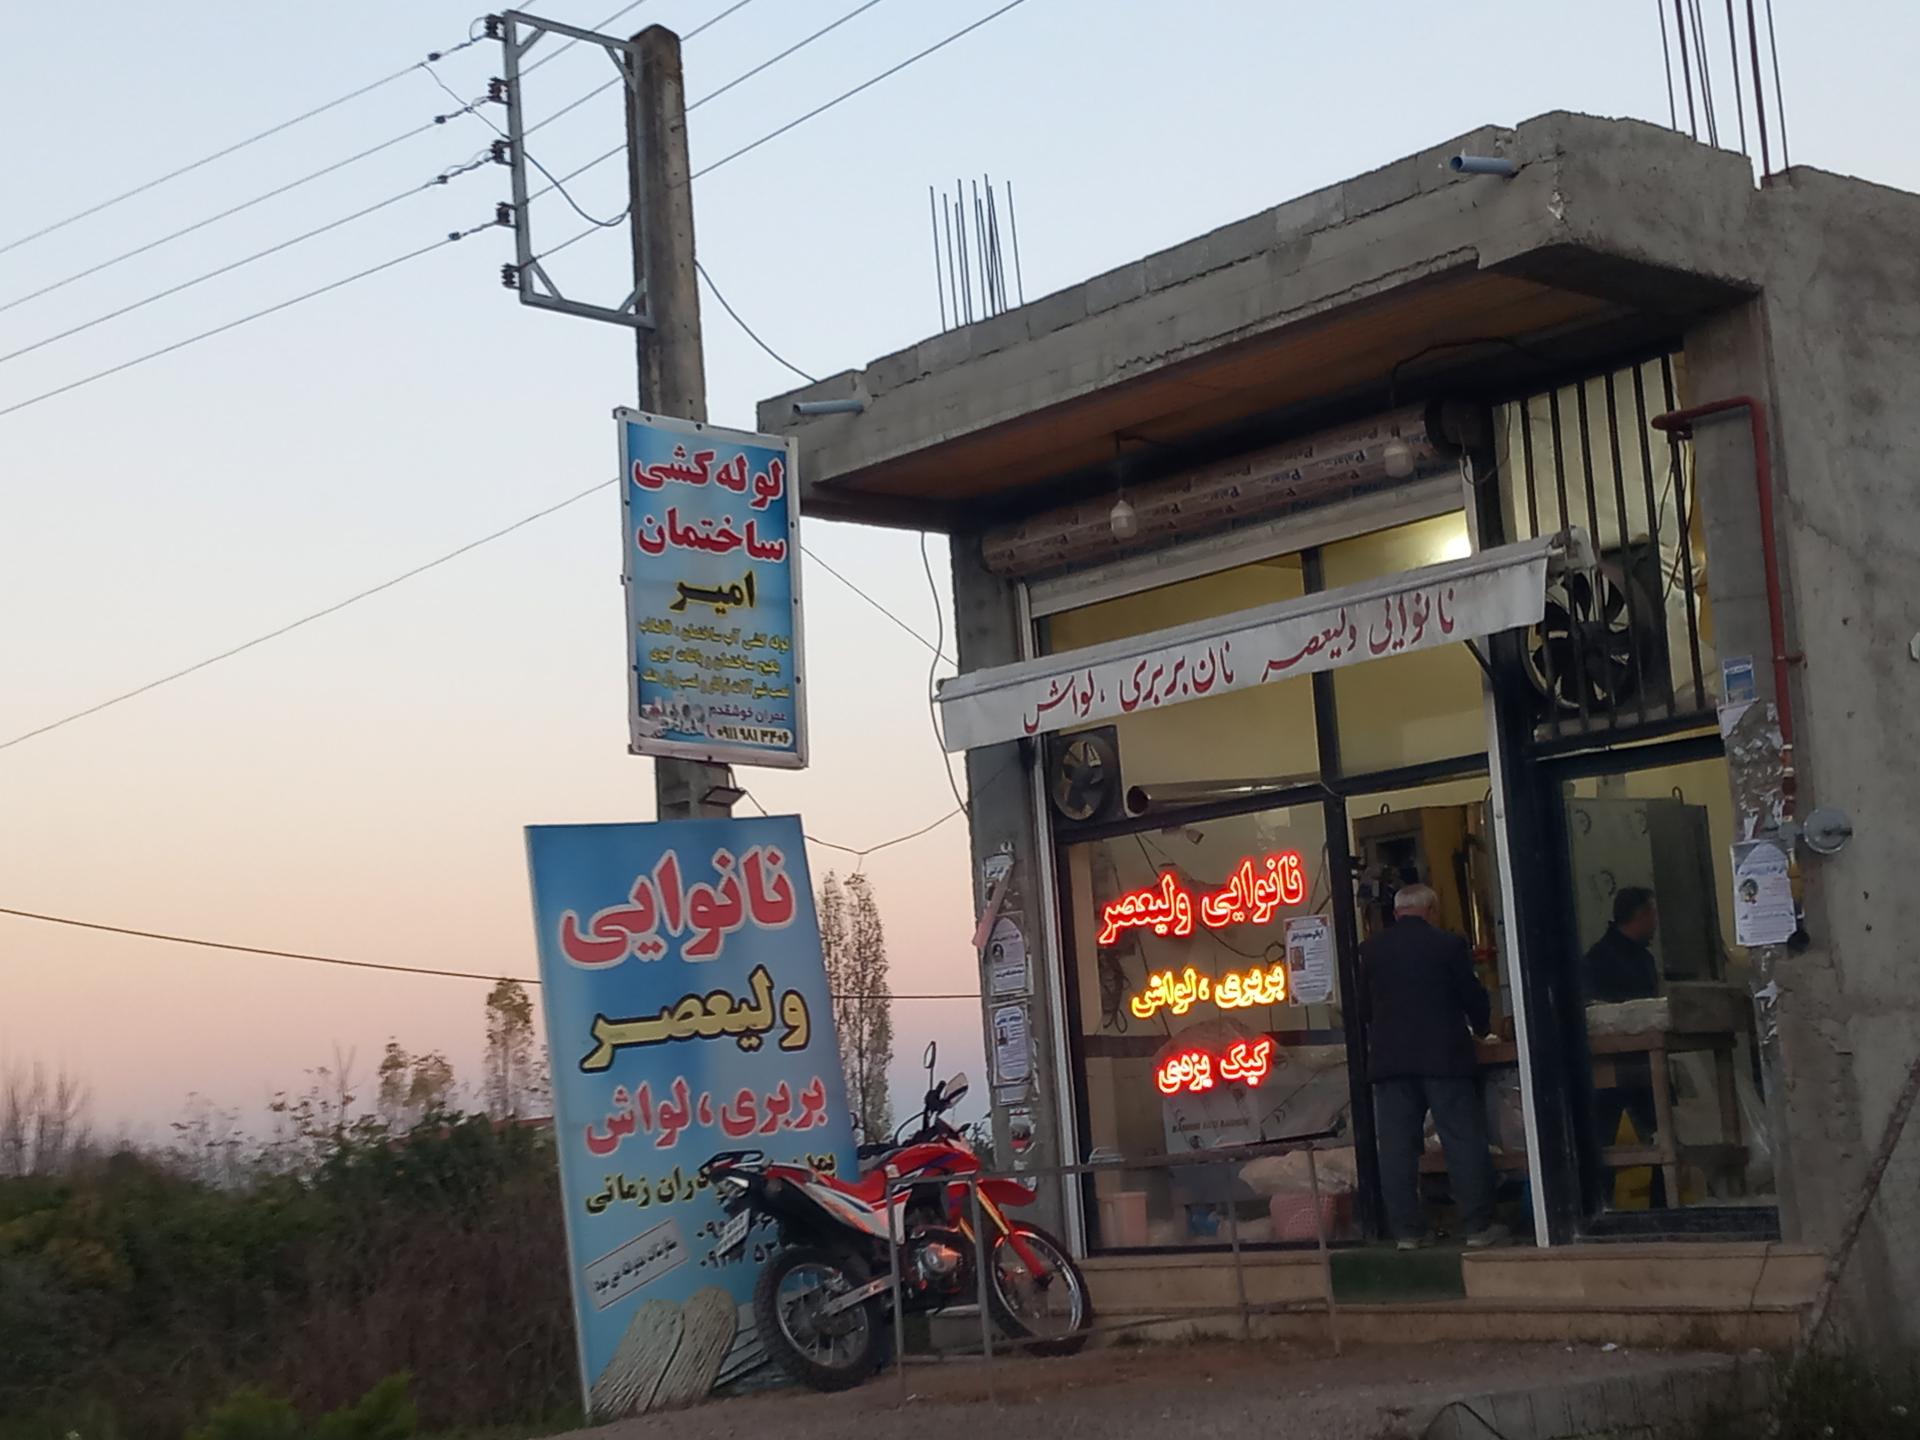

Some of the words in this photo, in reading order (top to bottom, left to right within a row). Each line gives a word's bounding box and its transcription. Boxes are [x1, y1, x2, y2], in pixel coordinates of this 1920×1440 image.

[633, 444, 715, 490] کشی
[716, 453, 784, 509] لوله
[637, 507, 787, 562] ساختمان
[669, 570, 757, 616] امیر
[1261, 606, 1358, 683] ولیعصر
[1369, 588, 1455, 656] نانوایی
[1119, 655, 1188, 713] بربری
[1192, 640, 1234, 694] نان
[560, 846, 797, 970] نانوایی
[1098, 873, 1193, 945] ولیعصر
[1201, 854, 1304, 928] نانوایی
[1214, 965, 1286, 1009] بربری
[579, 964, 810, 1073] ولیعصر
[1158, 1052, 1214, 1094] یزدی
[1219, 1041, 1271, 1085] کیک
[720, 1076, 828, 1138] بربری
[586, 1172, 651, 1215] زمانی
